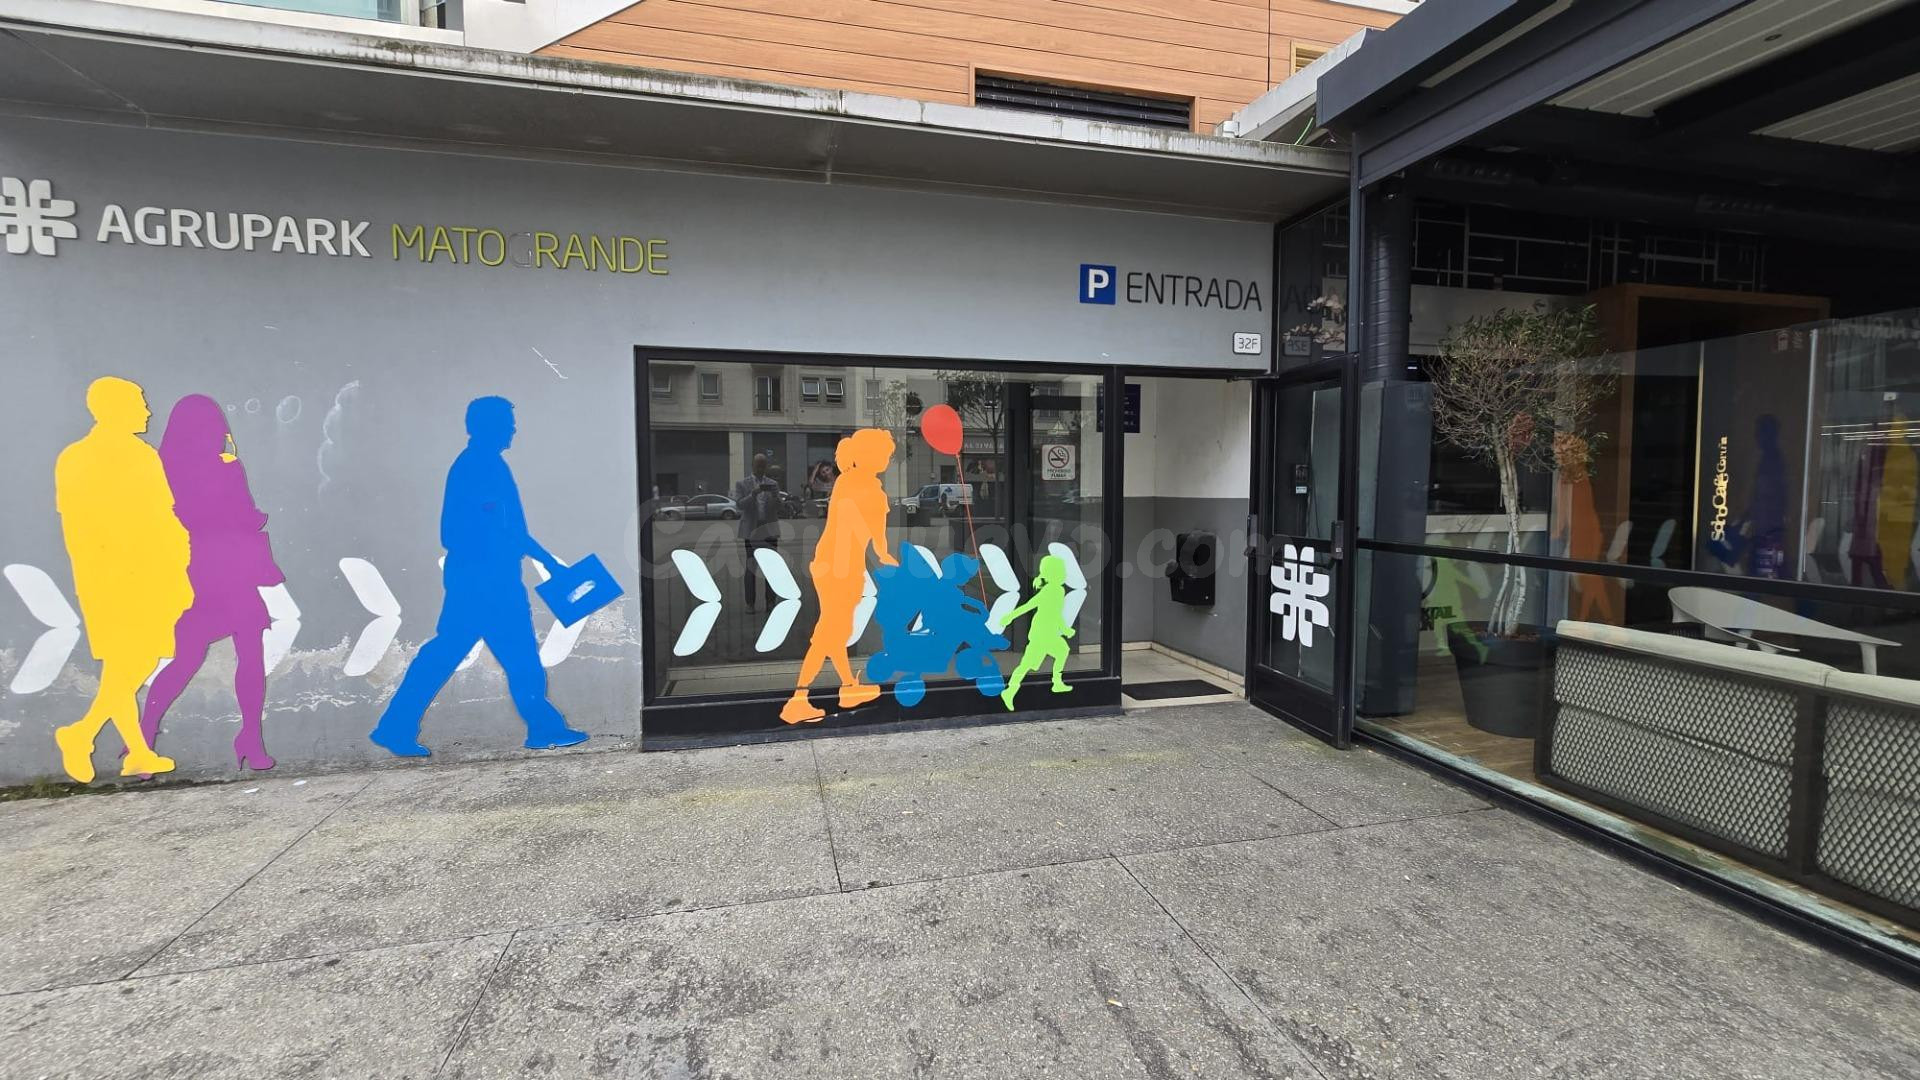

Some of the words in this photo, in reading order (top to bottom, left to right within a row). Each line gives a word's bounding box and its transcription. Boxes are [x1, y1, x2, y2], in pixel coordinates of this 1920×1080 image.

[97, 204, 371, 258] AGRUPARK
[1088, 268, 1109, 298] P
[1127, 272, 1262, 311] ENTRADA
[1238, 337, 1258, 350] 32F
